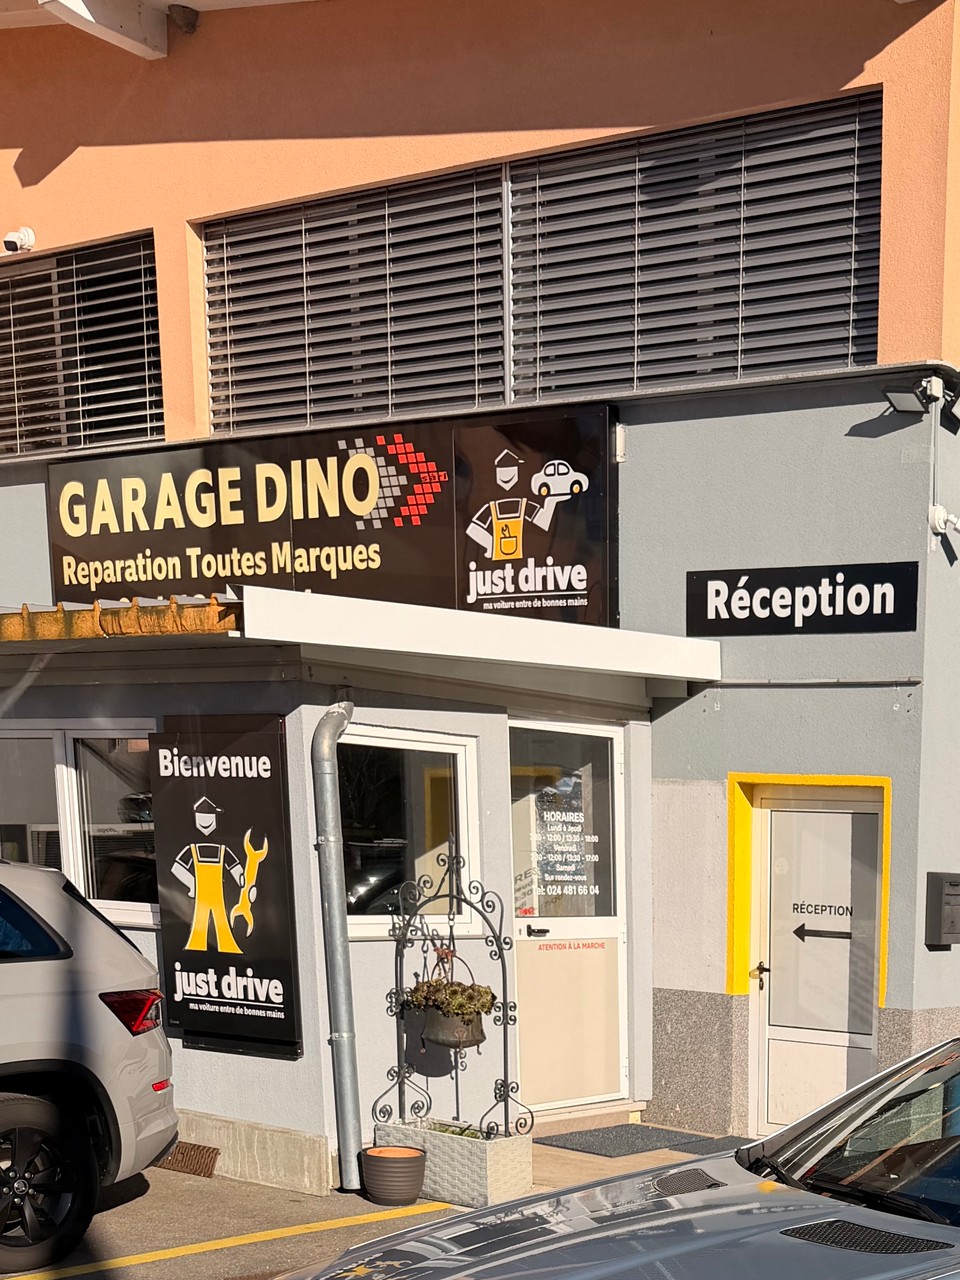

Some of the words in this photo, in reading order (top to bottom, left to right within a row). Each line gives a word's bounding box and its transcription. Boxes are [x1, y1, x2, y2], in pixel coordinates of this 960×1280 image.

[59, 467, 244, 538] GARAGE
[255, 453, 380, 523] DINO
[62, 548, 181, 592] Reparation
[186, 546, 267, 579] Toutes
[271, 541, 381, 580] Marques
[467, 561, 515, 603] just
[518, 556, 588, 592] drive
[483, 602, 493, 610] ma
[493, 600, 515, 609] voiture
[515, 599, 532, 608] entre
[532, 598, 542, 607] de
[542, 598, 567, 607] bonnes
[567, 596, 588, 606] mains
[707, 572, 895, 628] Réception
[158, 747, 272, 778] Bienvenue
[543, 811, 585, 823] HORAIRES
[546, 885, 562, 895] 024
[562, 885, 577, 895] 481
[577, 885, 588, 895] 66
[589, 885, 600, 895] 04
[792, 901, 853, 917] RÉCEPTION
[538, 943, 567, 951] ATENTION
[173, 961, 219, 1002] just
[221, 966, 284, 1004] drive
[189, 1002, 198, 1010] ma
[198, 1003, 220, 1012] voiture
[220, 1005, 236, 1014] entre
[235, 1006, 244, 1014] de
[244, 1007, 266, 1017] bonnes
[266, 1009, 285, 1019] mains
